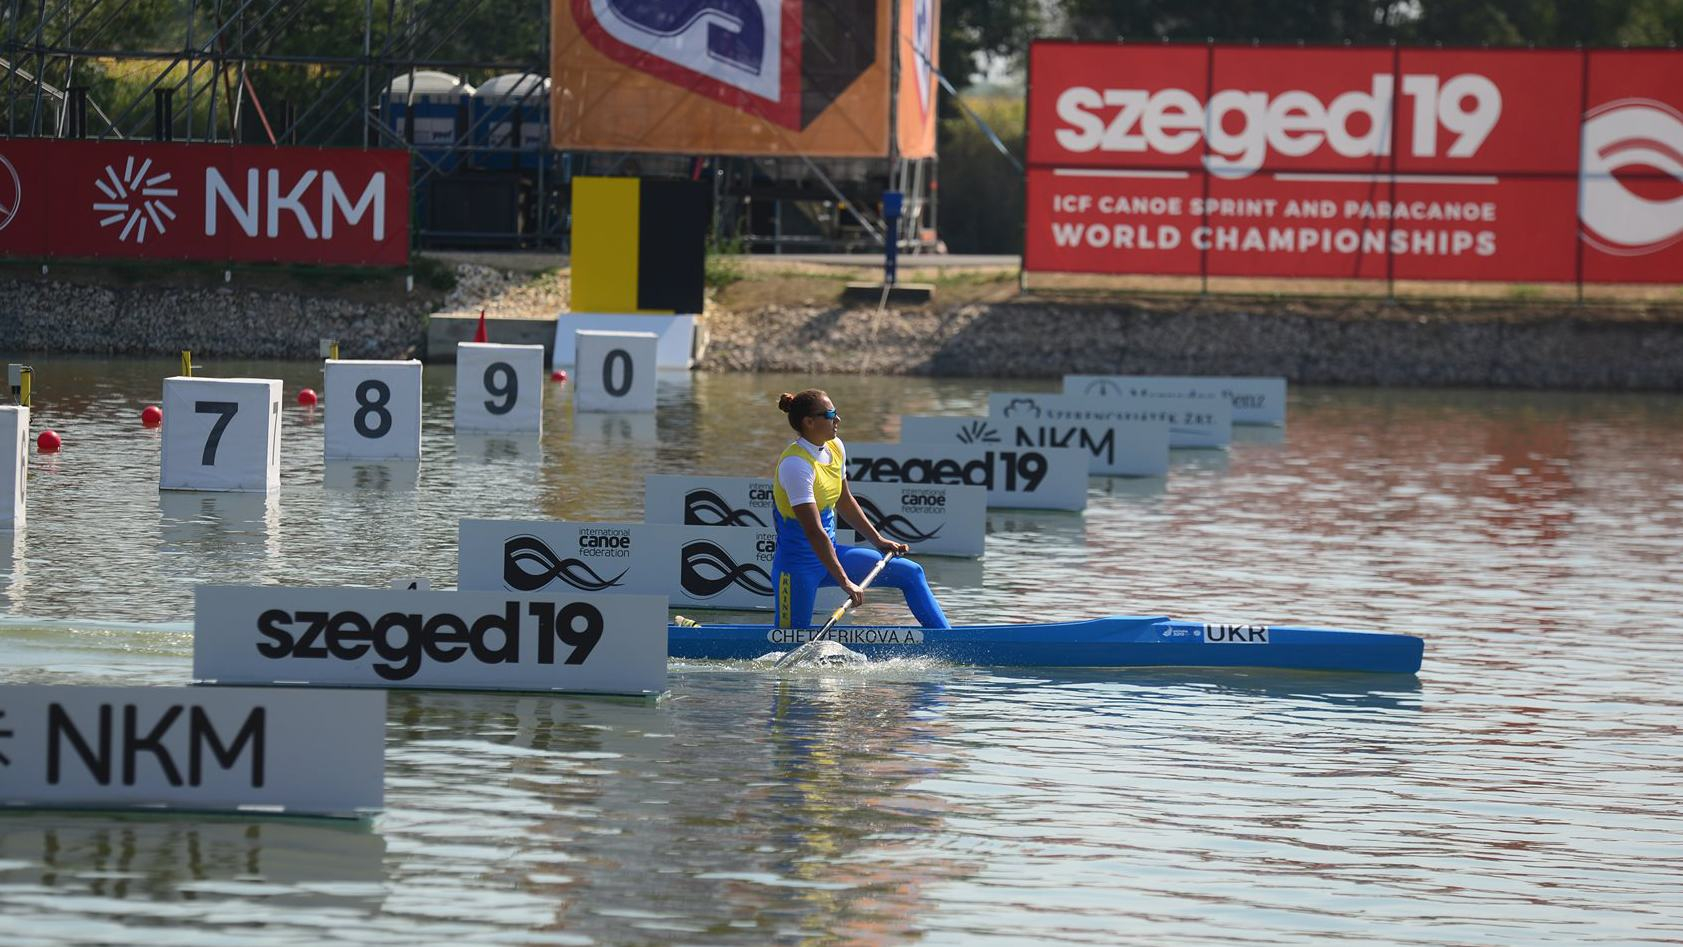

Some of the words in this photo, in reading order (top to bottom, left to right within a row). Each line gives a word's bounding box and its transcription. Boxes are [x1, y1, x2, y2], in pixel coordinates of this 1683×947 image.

[205, 166, 386, 242] NKM
[1053, 195, 1092, 213] ICF
[1098, 196, 1182, 215] CANOE
[1190, 198, 1278, 216] SPRINT
[1284, 200, 1337, 218] AND
[1344, 202, 1496, 221] PARACANOE
[1051, 223, 1182, 250] WORLD
[1191, 226, 1496, 256] CHAMPIONSHIPS
[602, 349, 634, 397] 0
[483, 362, 518, 416] 9
[353, 380, 393, 439] 8
[195, 401, 239, 466] 7
[901, 494, 946, 506] canoe
[902, 505, 946, 514] federation
[579, 528, 630, 536] international
[579, 536, 630, 548] canoe
[579, 548, 630, 557] federation
[904, 630, 919, 644] A.
[1207, 625, 1266, 642] UKR
[45, 702, 266, 788] NKM
